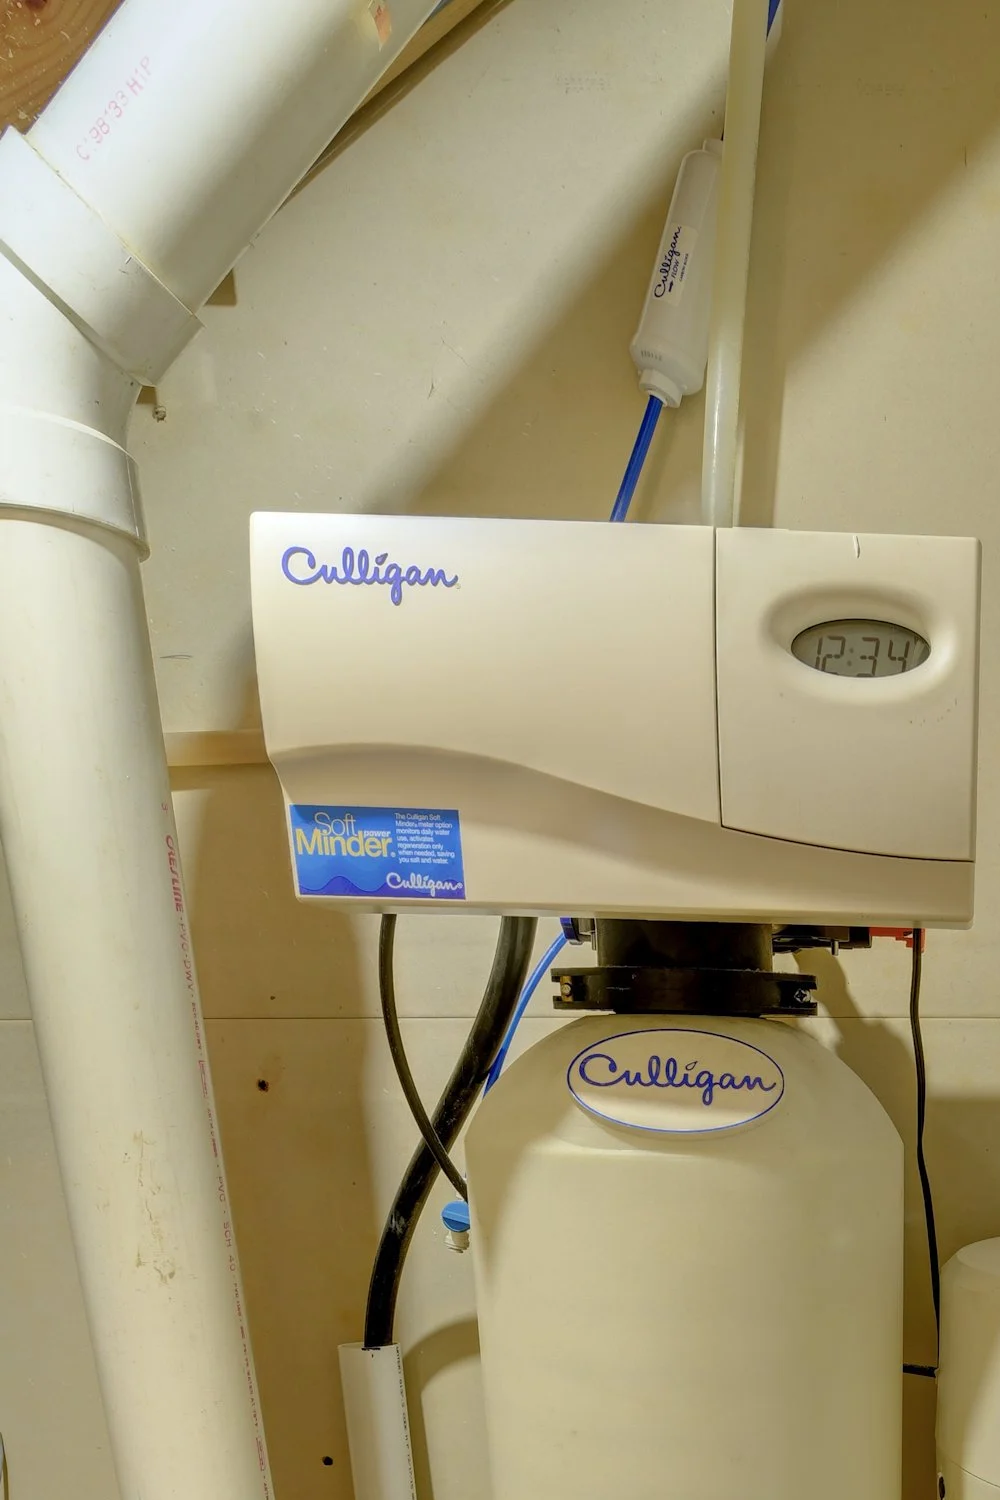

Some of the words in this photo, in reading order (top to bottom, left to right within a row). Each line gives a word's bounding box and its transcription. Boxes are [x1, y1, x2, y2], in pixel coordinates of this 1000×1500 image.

[654, 226, 682, 297] Culligan
[281, 546, 459, 605] Culligan
[815, 635, 911, 677] 12:34
[314, 812, 356, 837] Soft
[364, 830, 391, 838] power
[407, 813, 428, 821] Culligan
[166, 834, 184, 913] CRESLINE
[386, 872, 459, 897] Culligan
[579, 1052, 777, 1107] Culligan
